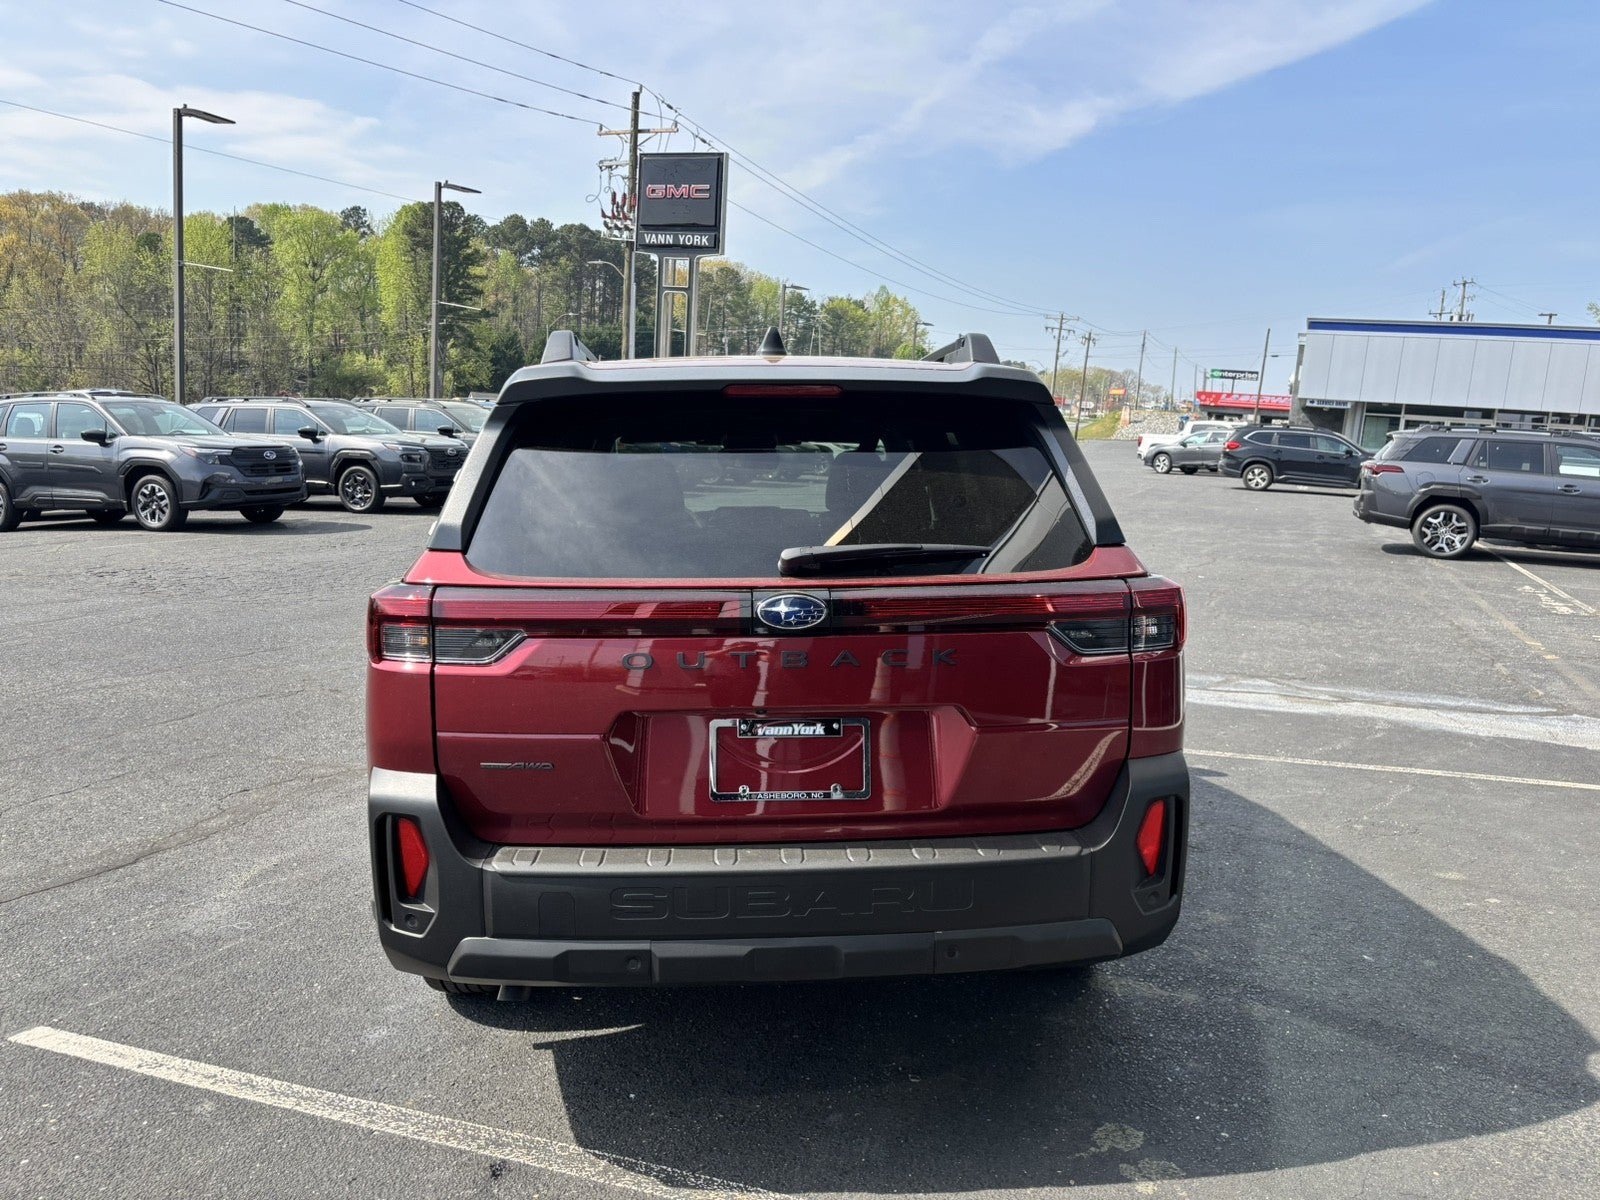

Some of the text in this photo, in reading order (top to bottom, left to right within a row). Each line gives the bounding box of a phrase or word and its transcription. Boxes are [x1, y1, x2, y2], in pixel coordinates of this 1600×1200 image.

[646, 184, 710, 199] GMC
[644, 233, 709, 246] VANN YORK
[1213, 370, 1258, 379] enterprise
[622, 650, 957, 670] OUTBACK
[508, 762, 554, 770] AWD
[609, 879, 975, 921] SUBARU
